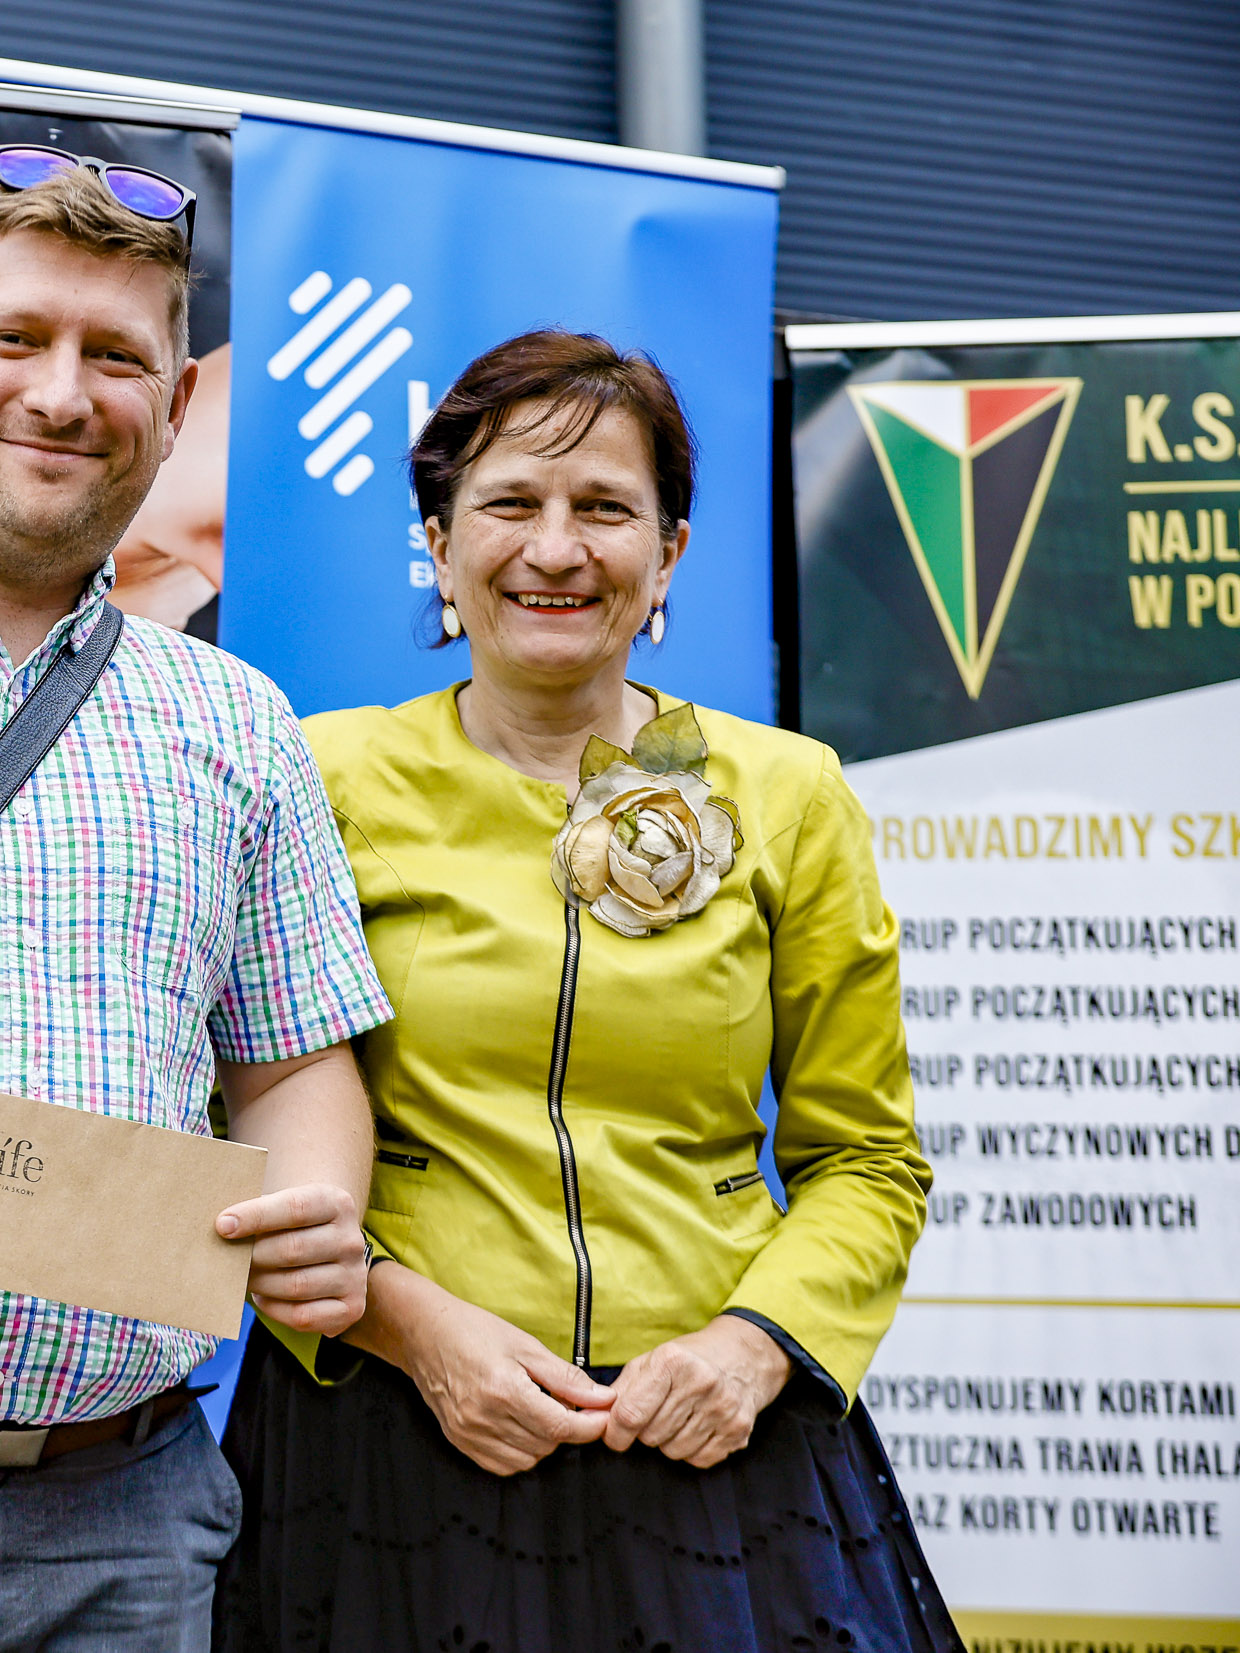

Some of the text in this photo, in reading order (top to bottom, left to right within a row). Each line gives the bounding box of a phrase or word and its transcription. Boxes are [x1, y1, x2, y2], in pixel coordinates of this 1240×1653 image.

[1124, 392, 1240, 464] K.S
[1127, 509, 1240, 564] NAJL
[1129, 572, 1240, 629] W PO
[967, 915, 1237, 959] POCZĄTKUJĄCYCH
[971, 984, 1240, 1028] POCZĄTKUJĄCYCH
[976, 1121, 1213, 1157] WYCZYNOWYCH
[980, 1192, 1197, 1228] ZAWODOWYCH
[866, 1376, 1236, 1417] DYSPONUJEMY KORTAMI
[1034, 1437, 1144, 1473] TRAWA
[961, 1497, 1058, 1532] KORTY
[1072, 1500, 1221, 1537] OTWARTE
